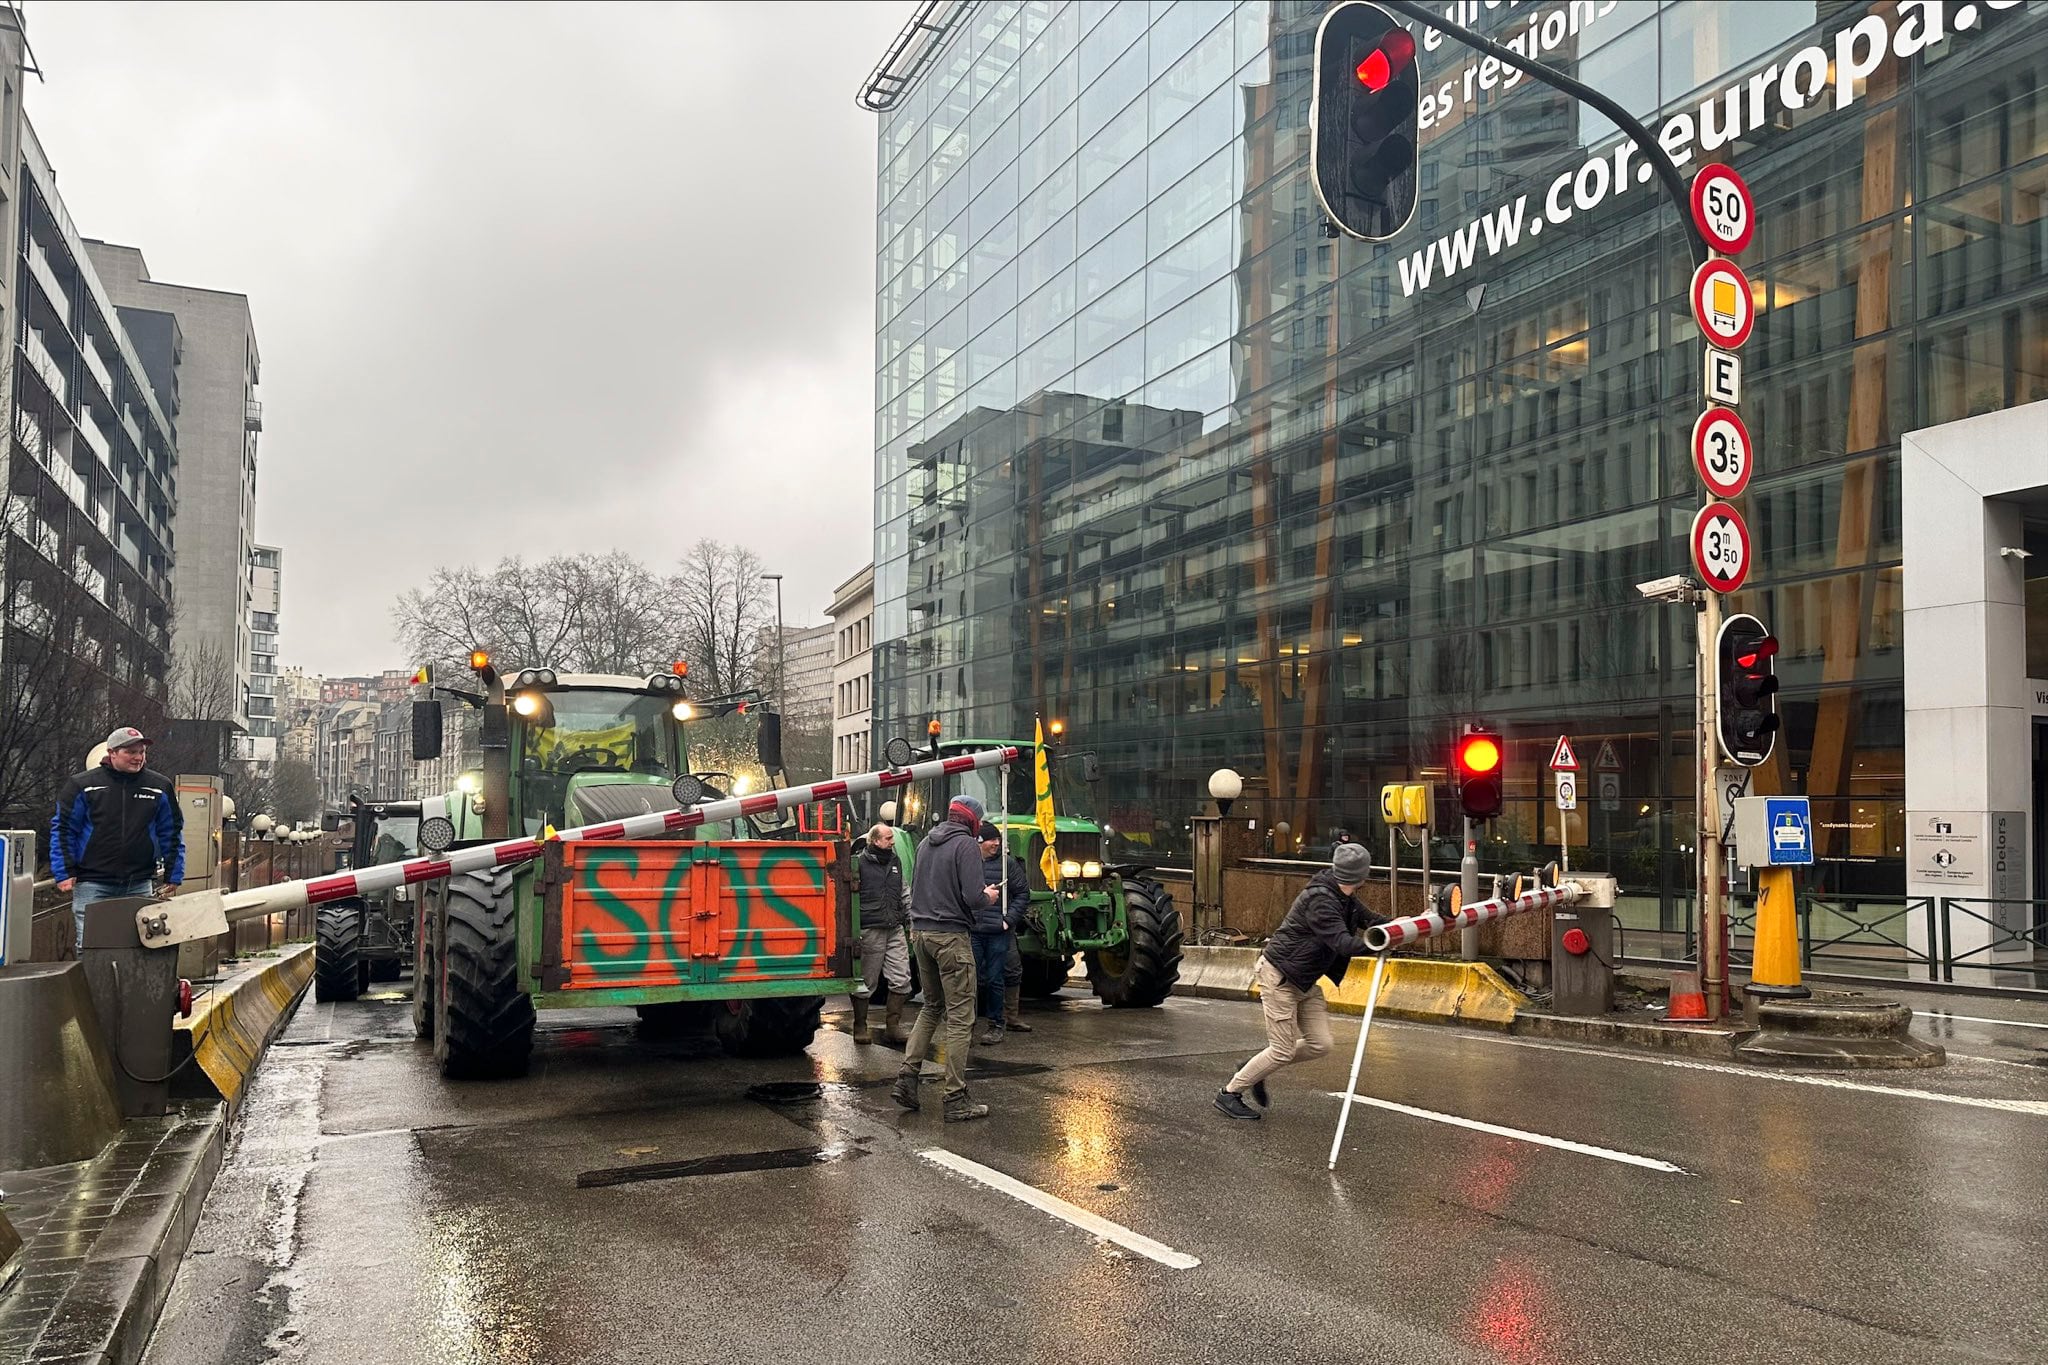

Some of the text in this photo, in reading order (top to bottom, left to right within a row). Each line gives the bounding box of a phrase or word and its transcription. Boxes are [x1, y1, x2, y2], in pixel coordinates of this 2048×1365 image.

[1418, 80, 1454, 130] es
[1709, 185, 1740, 222] 50
[1717, 218, 1733, 237] km
[1716, 359, 1733, 396] E
[1724, 774, 1743, 782] ZONE
[1996, 818, 2006, 872] Delors
[581, 846, 826, 982] SOS
